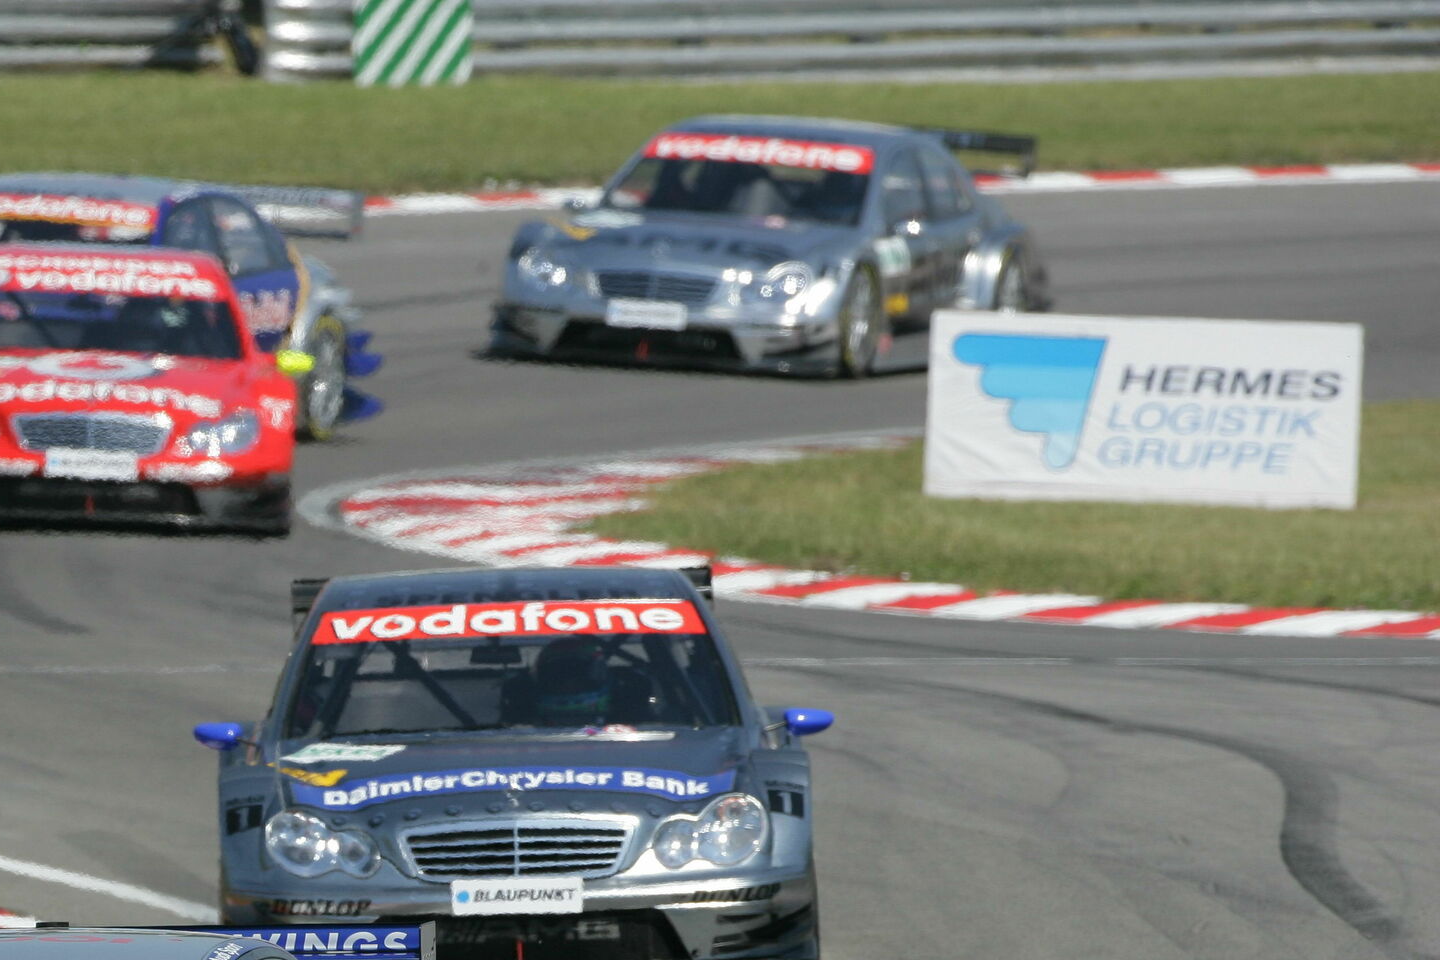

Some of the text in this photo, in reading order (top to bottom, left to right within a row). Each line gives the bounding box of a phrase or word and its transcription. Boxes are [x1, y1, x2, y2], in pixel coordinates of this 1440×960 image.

[656, 136, 863, 172] vodafone
[17, 271, 218, 298] vodafone
[1119, 364, 1343, 400] HERMES
[1106, 400, 1325, 438] LOGISTIK
[1096, 434, 1295, 475] GRUPPE
[330, 602, 685, 640] vodafone
[323, 768, 613, 806] DaimlerChrysler
[622, 769, 709, 796] Bank
[472, 887, 579, 903] BLAUPUNKT
